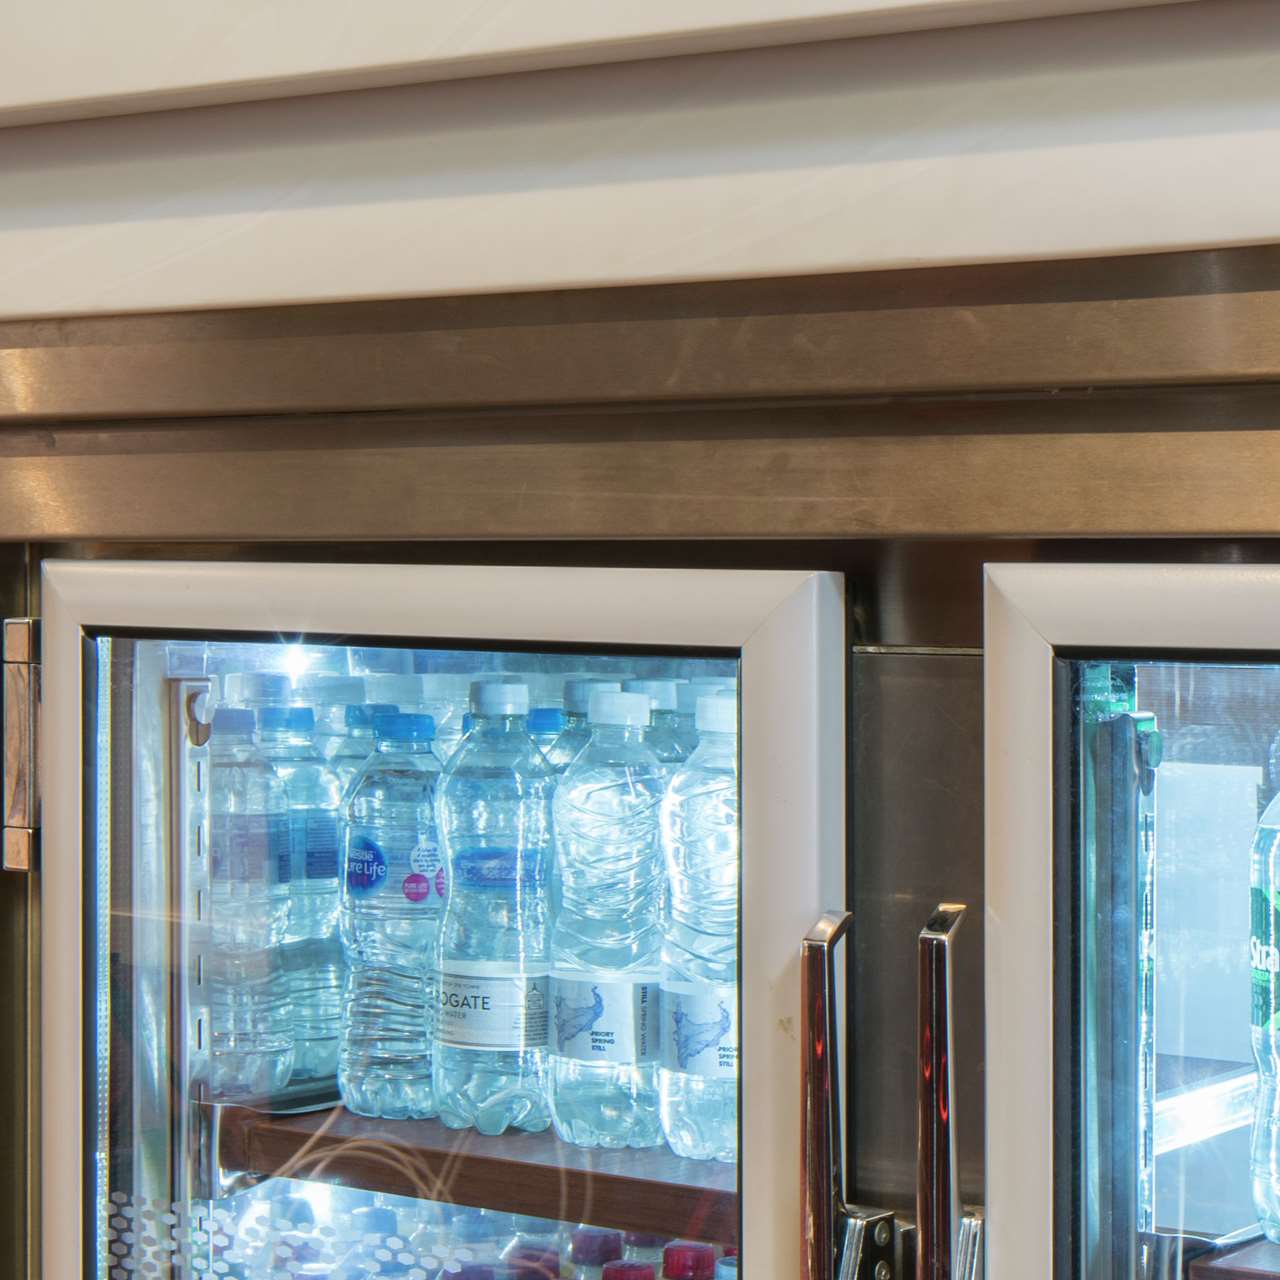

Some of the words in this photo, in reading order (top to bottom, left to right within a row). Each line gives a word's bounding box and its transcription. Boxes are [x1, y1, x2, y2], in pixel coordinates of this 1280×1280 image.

[364, 861, 386, 881] Life
[438, 990, 491, 1011] OGATE
[640, 986, 648, 1005] STILL
